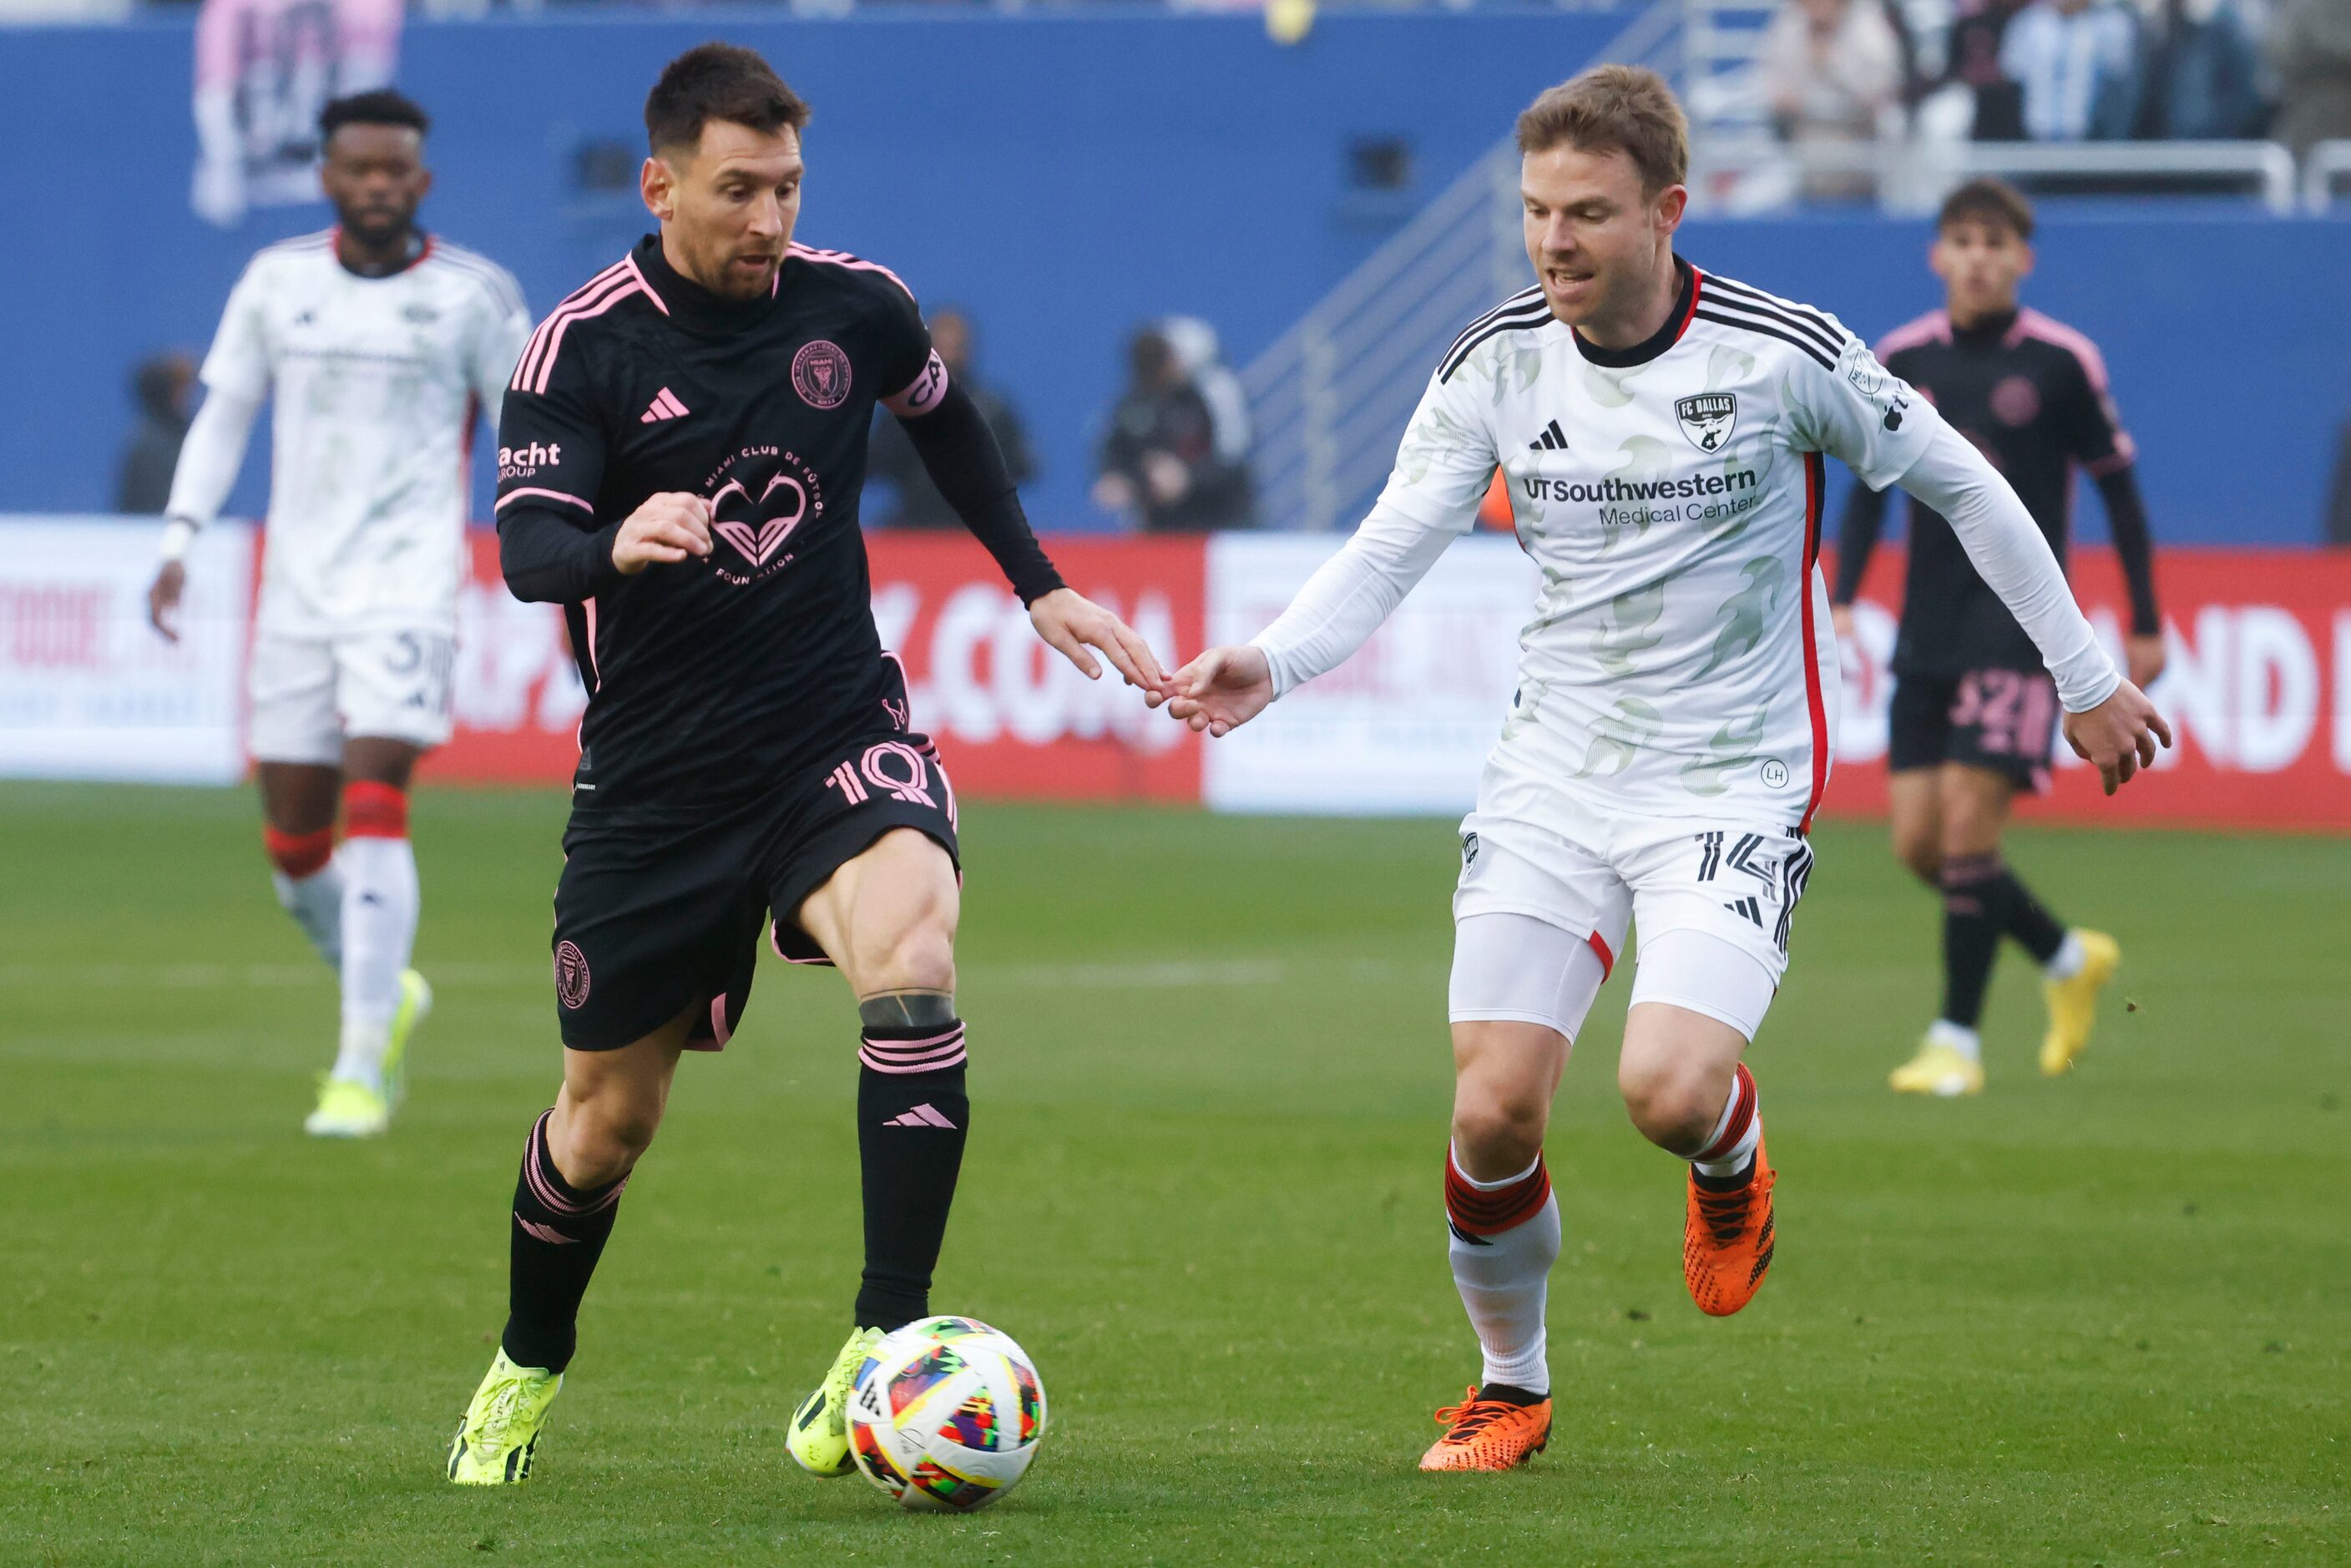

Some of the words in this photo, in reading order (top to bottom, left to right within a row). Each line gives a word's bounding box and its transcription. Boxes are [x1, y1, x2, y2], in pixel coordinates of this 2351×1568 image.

[1681, 402, 1694, 417] FC
[1696, 397, 1731, 413] DALLAS
[705, 454, 736, 487] MIAMI
[741, 445, 779, 458] CLUB
[785, 451, 801, 465] DE
[1599, 504, 1681, 525] Medical
[1686, 494, 1757, 520] Center
[715, 552, 794, 584] FOUNATION
[823, 741, 938, 806] 10
[1766, 767, 1783, 781] LH
[1694, 831, 1777, 903] 14
